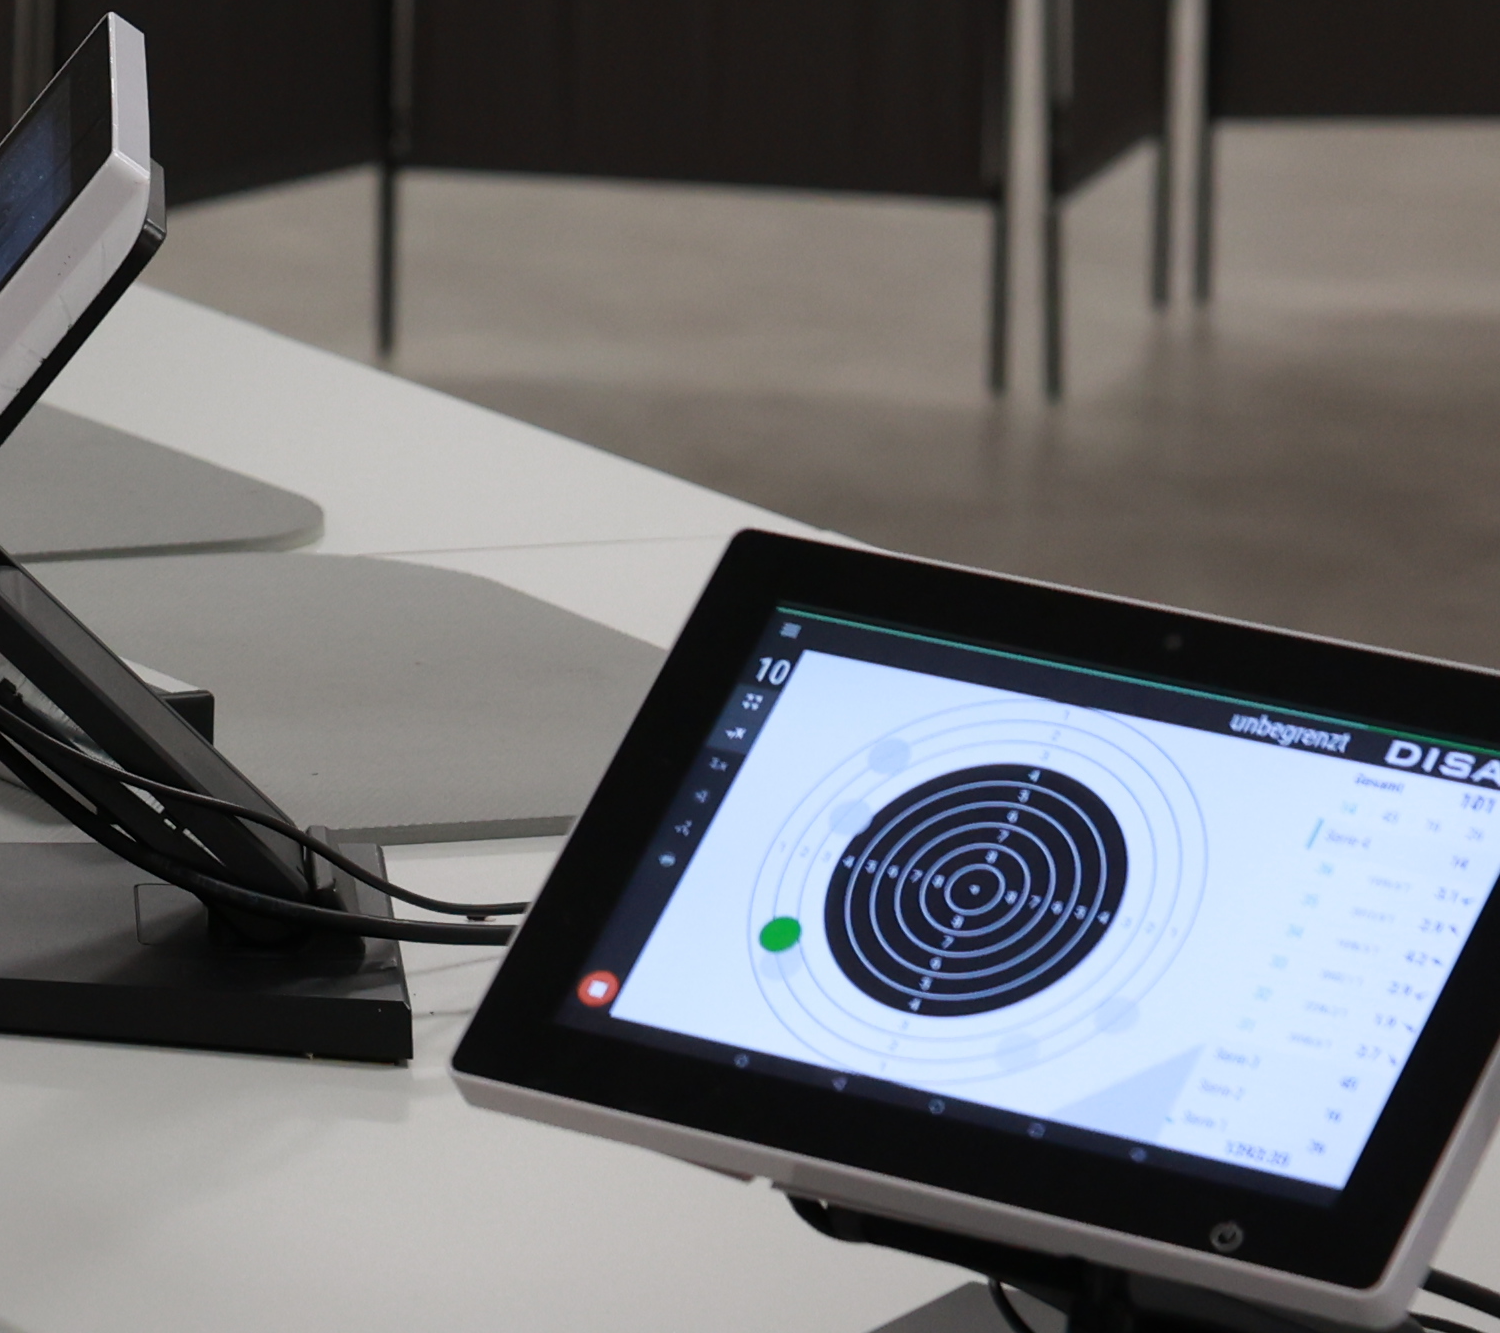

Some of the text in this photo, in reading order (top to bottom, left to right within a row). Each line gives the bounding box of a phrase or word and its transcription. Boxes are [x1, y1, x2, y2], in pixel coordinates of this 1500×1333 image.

[755, 656, 791, 685] 10
[1229, 713, 1352, 753] unbegrenzt
[1383, 738, 1500, 787] DISA
